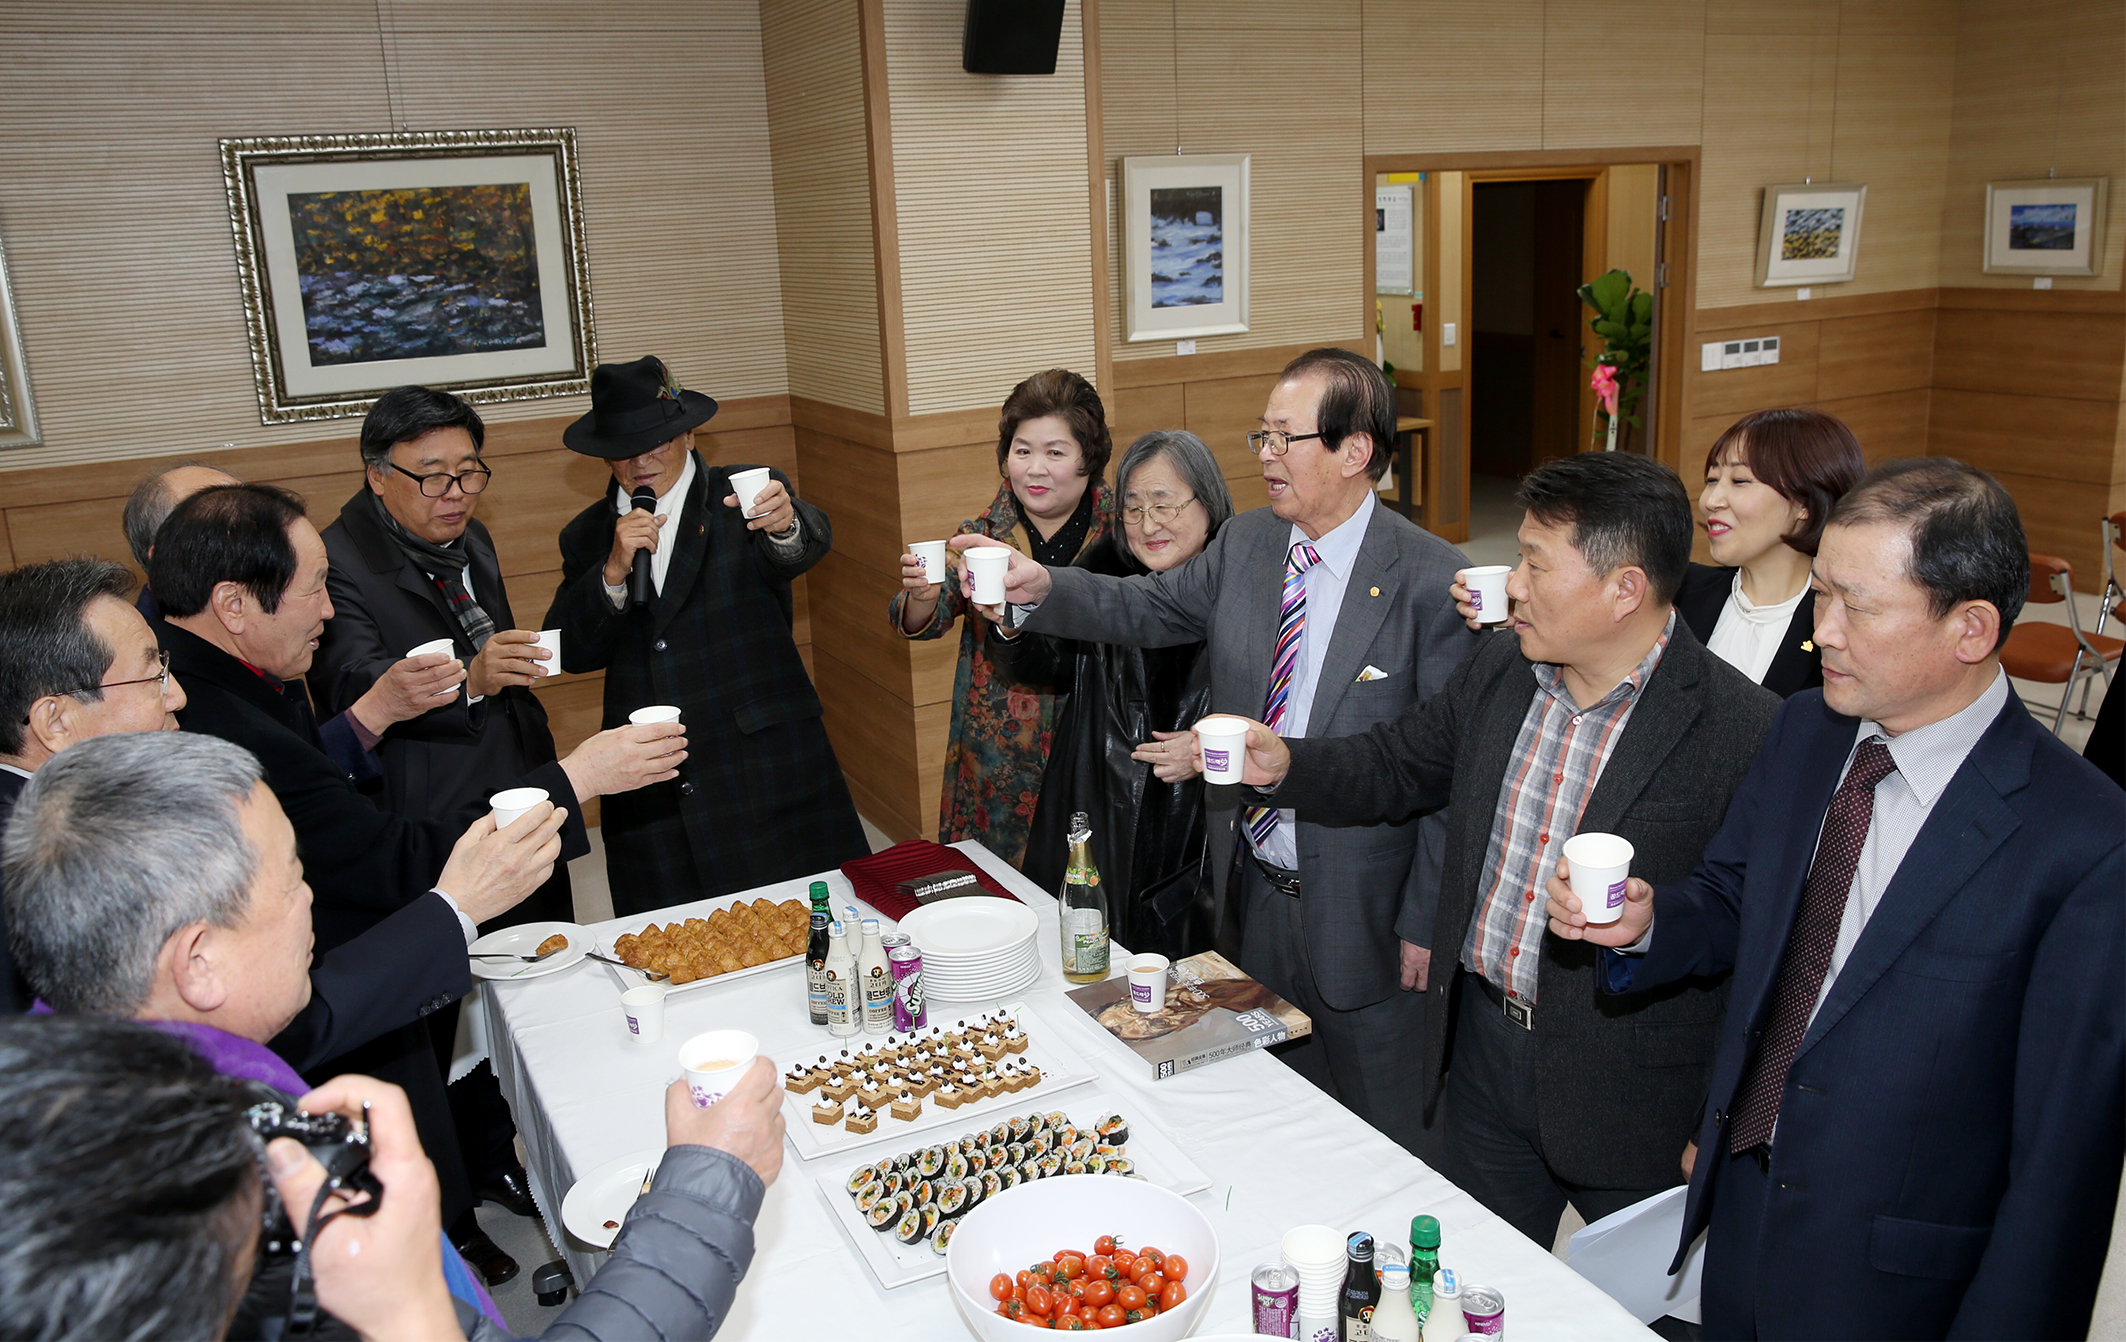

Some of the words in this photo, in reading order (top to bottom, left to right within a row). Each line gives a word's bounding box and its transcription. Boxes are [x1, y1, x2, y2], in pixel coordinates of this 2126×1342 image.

[1235, 1014, 1265, 1033] 500
[1250, 1010, 1274, 1028] YEARS
[1254, 1030, 1286, 1048] 色彩人物
